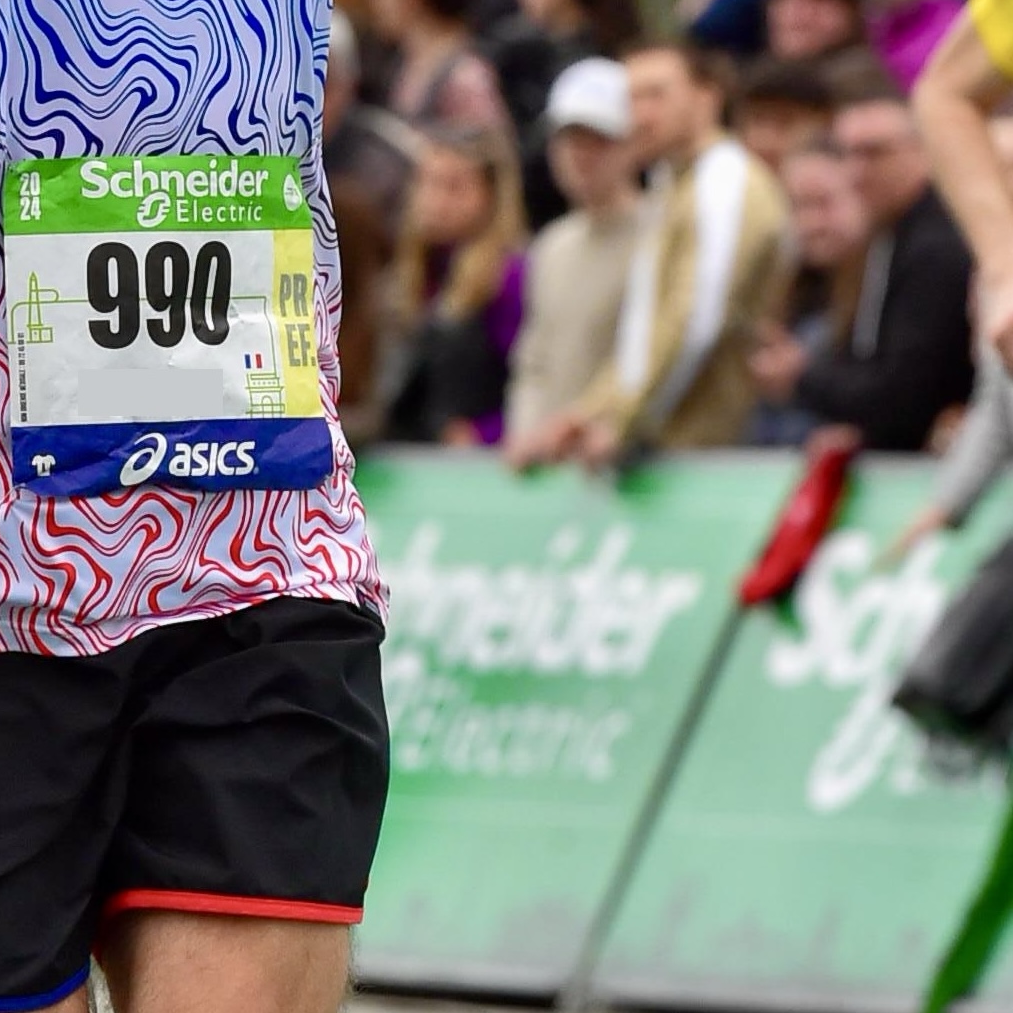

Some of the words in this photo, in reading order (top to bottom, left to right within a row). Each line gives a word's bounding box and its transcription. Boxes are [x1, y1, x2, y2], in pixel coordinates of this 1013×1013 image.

[20, 172, 41, 196] 20
[80, 159, 269, 198] Schneider
[20, 196, 42, 220] 24
[176, 199, 263, 223] Electric
[87, 240, 232, 349] 990
[279, 273, 309, 317] PR
